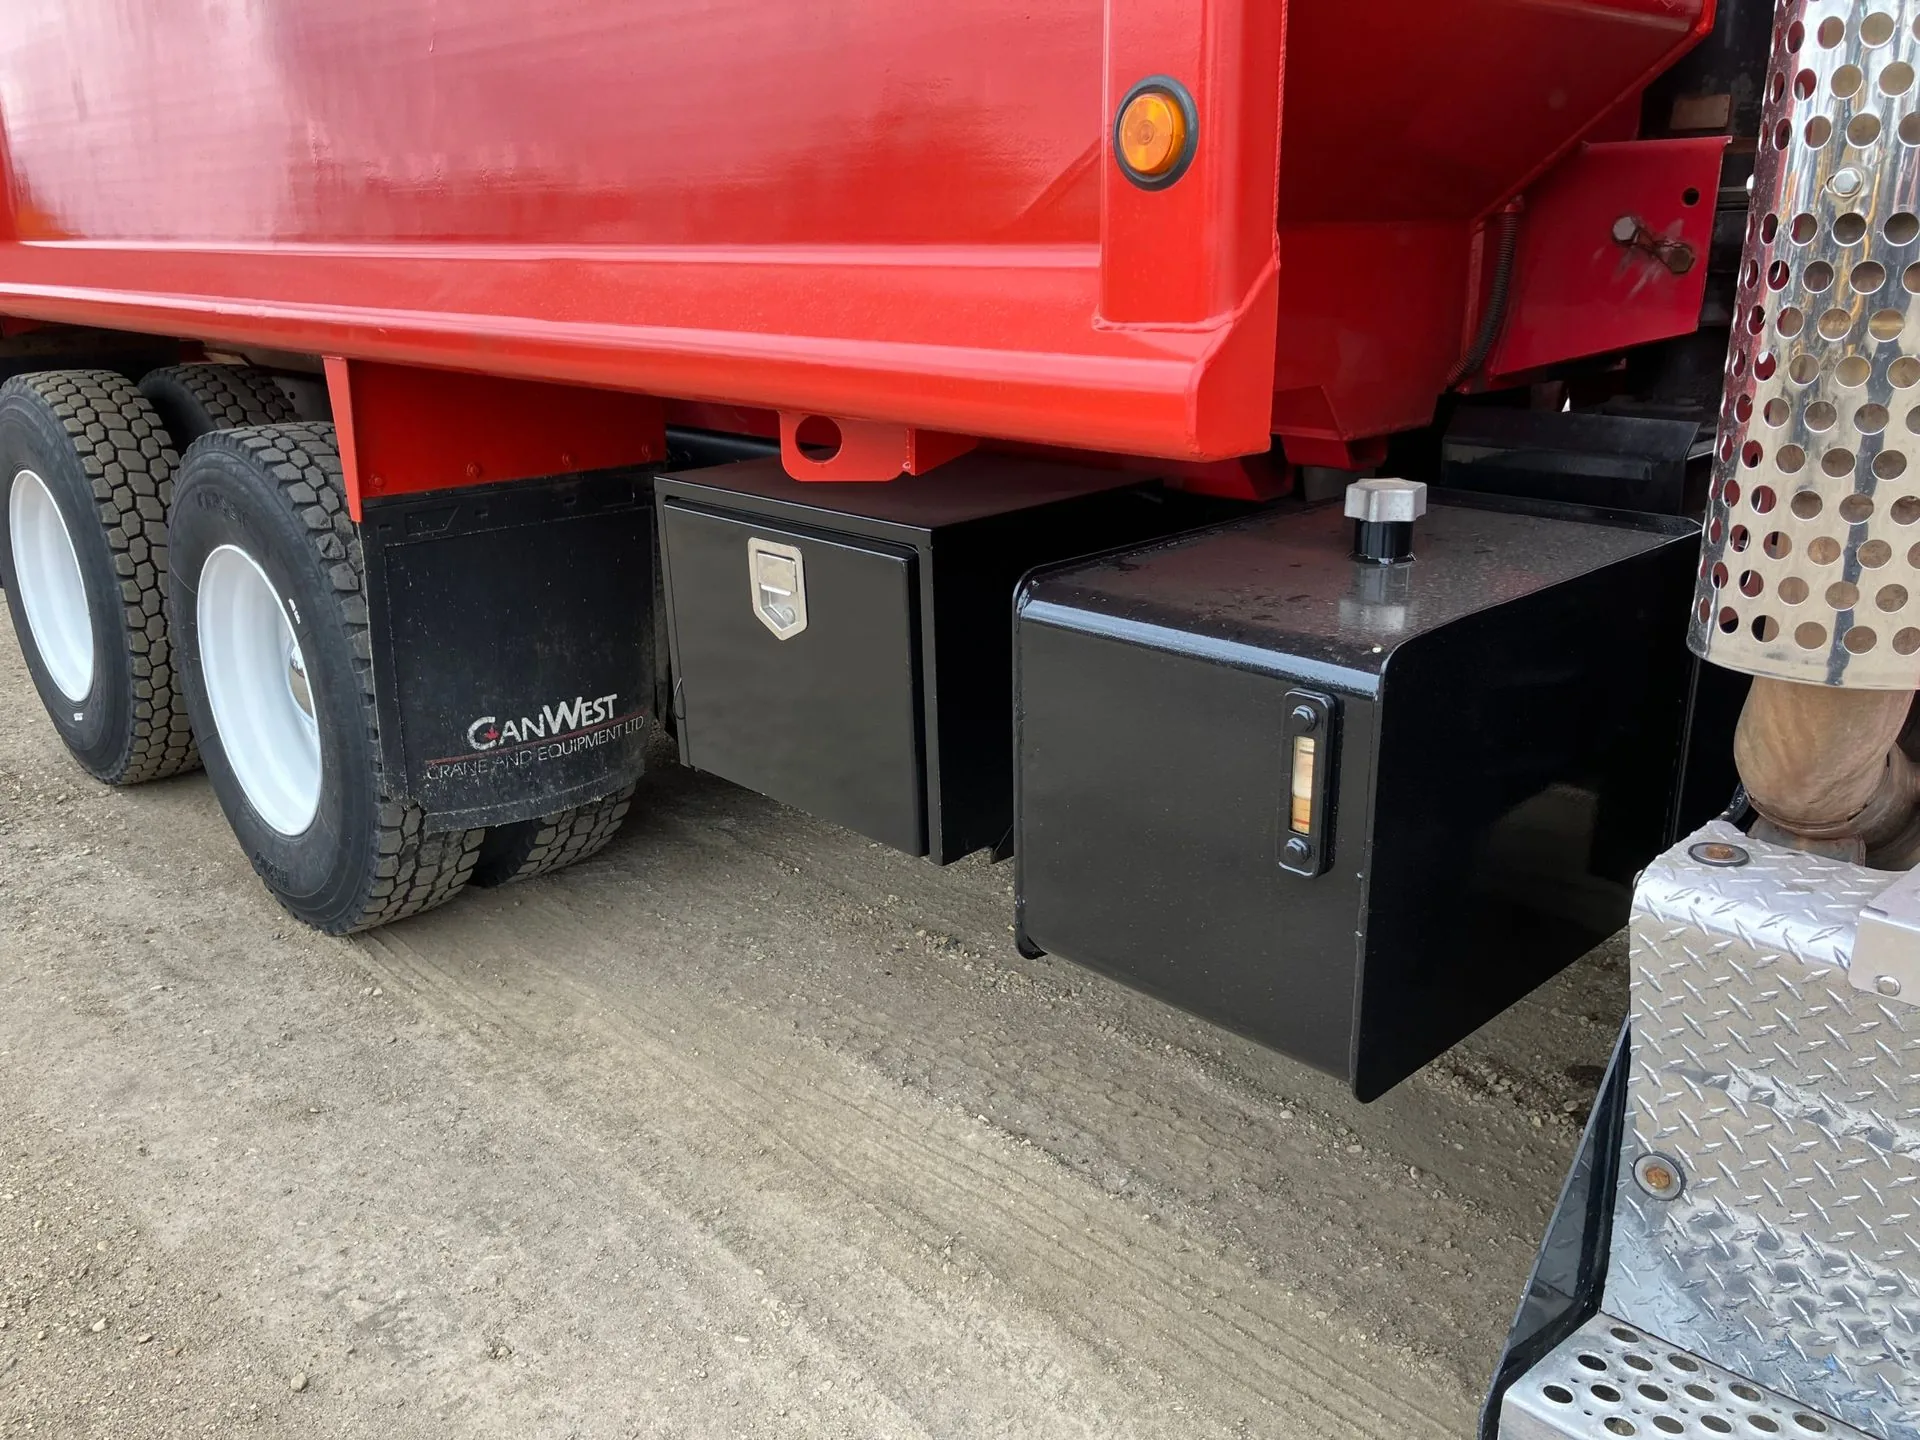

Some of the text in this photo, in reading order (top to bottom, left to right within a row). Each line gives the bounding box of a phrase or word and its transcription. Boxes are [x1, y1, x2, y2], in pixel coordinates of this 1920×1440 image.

[426, 715, 644, 780] CRANE AND EQUIPMENT LTD
